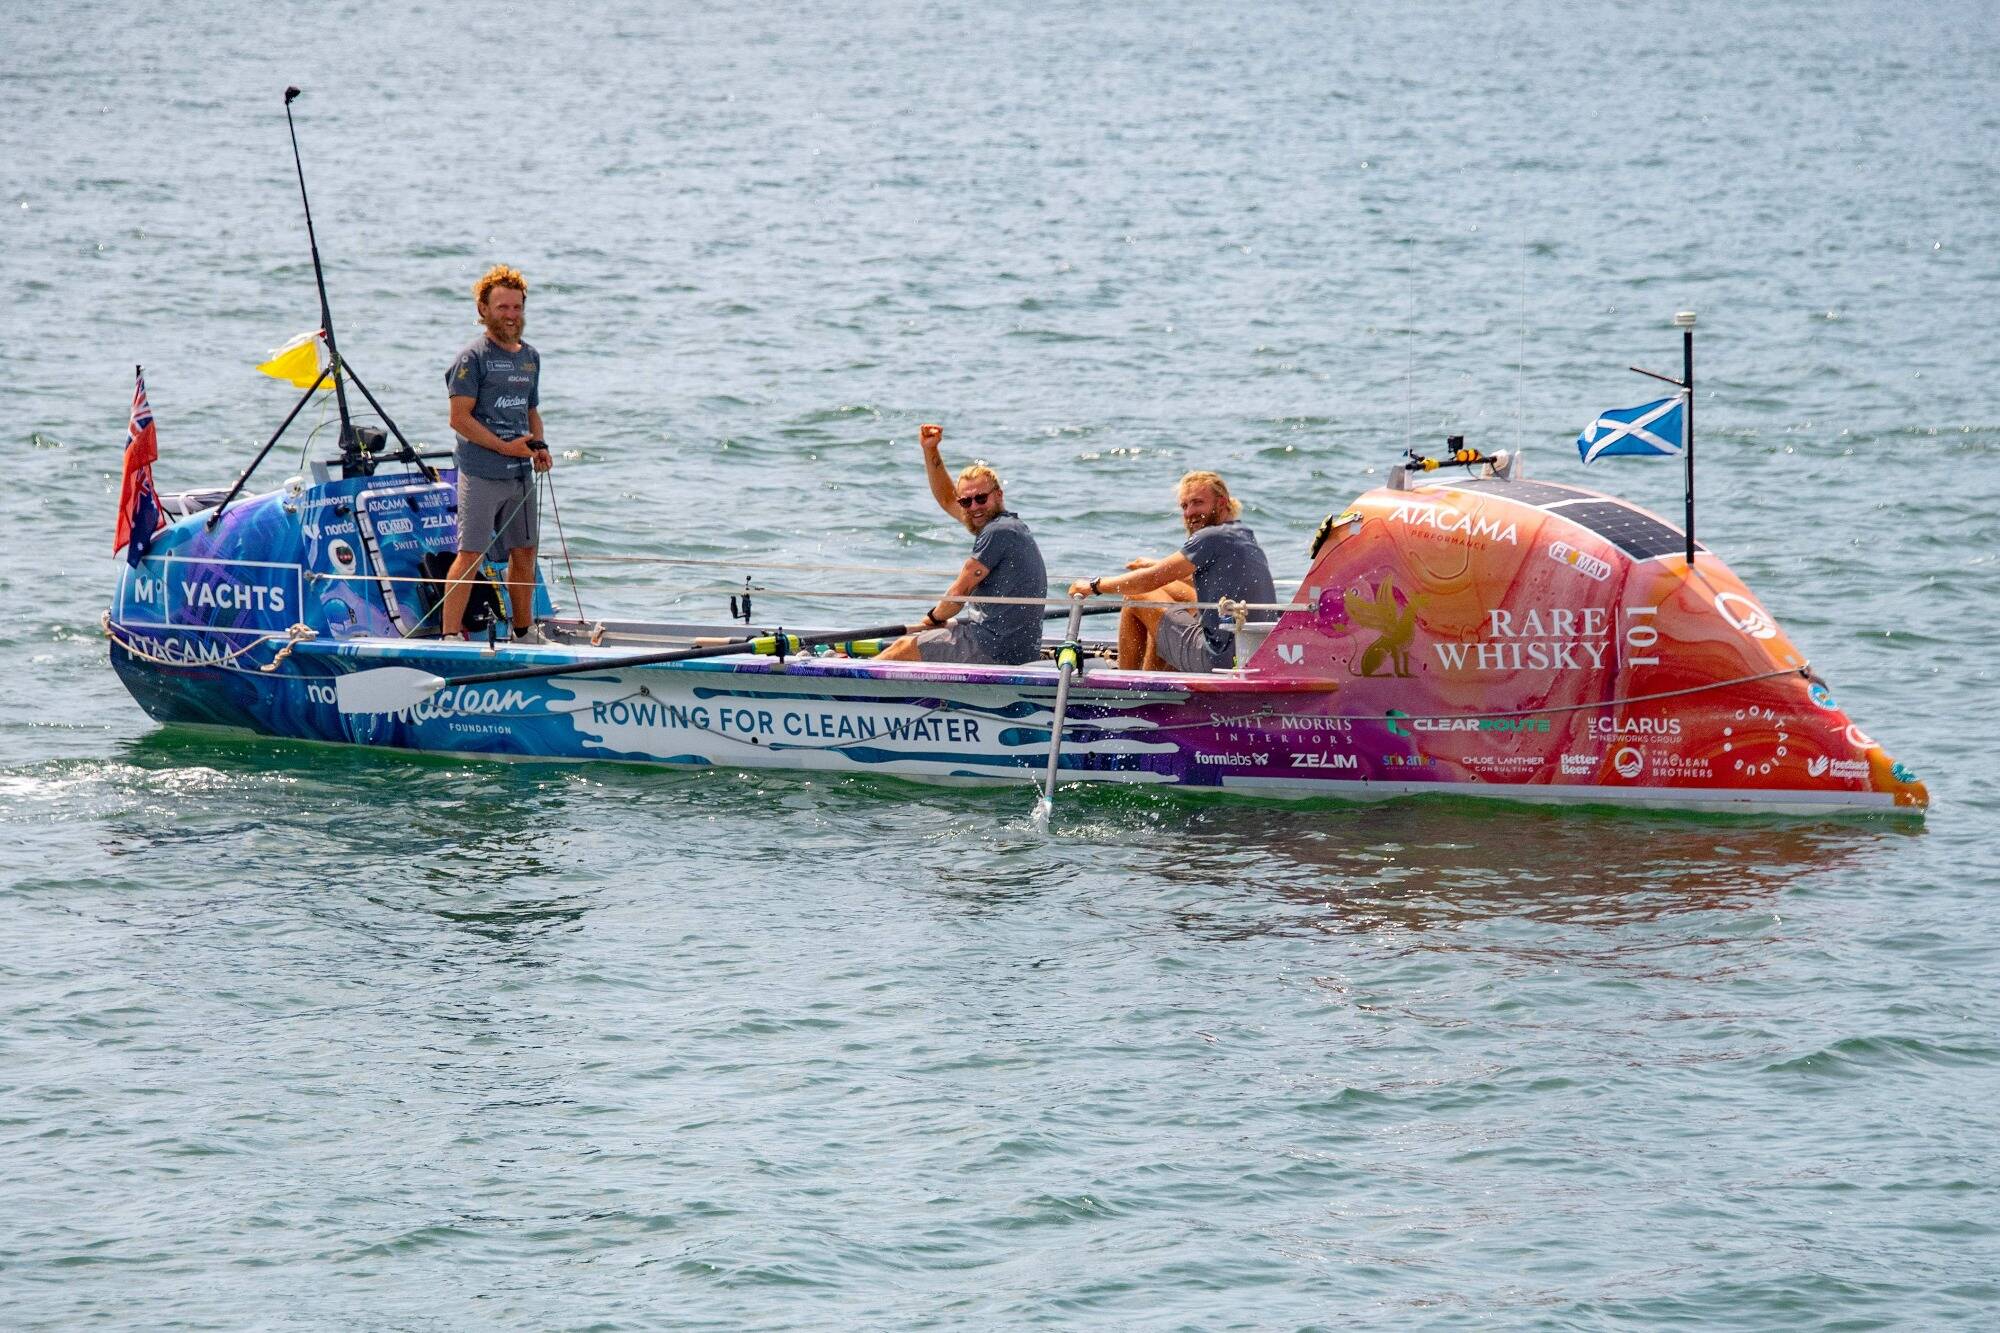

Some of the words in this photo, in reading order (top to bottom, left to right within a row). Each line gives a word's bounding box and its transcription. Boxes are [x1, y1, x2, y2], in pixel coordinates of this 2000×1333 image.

[368, 498, 409, 513] ATACAMA
[1388, 504, 1518, 546] ATACAMA
[393, 539, 419, 550] SWIFT
[425, 535, 458, 547] MORRIS
[1410, 529, 1487, 551] PERFORMANCE
[181, 581, 285, 612] YACHTS
[1487, 607, 1609, 638] RARE
[1626, 605, 1660, 669] 101
[127, 633, 241, 672] ATACAMA
[1433, 641, 1610, 670] WHISKY
[449, 722, 512, 735] FOUNDATION
[592, 700, 710, 729] ROWING
[719, 708, 774, 735] FOR
[784, 712, 883, 740] CLEAN
[884, 716, 981, 743] WATER
[1210, 712, 1263, 729] SWIFT
[1281, 716, 1352, 731] MORRIS
[1413, 718, 1550, 733] CLEARROUTE
[1587, 717, 1597, 740] THE
[1598, 717, 1681, 735] CLARUS
[1215, 732, 1353, 744] INTERIORS
[1600, 734, 1648, 743] NETWORKS
[1650, 735, 1682, 744] GROUP
[1195, 751, 1251, 766] formlabs
[1290, 750, 1358, 768] ZELIM
[1498, 757, 1545, 765] LANTHIER
[1560, 754, 1598, 765] Better
[1561, 764, 1591, 775] Beer.
[1652, 768, 1713, 778] BROTHERS
